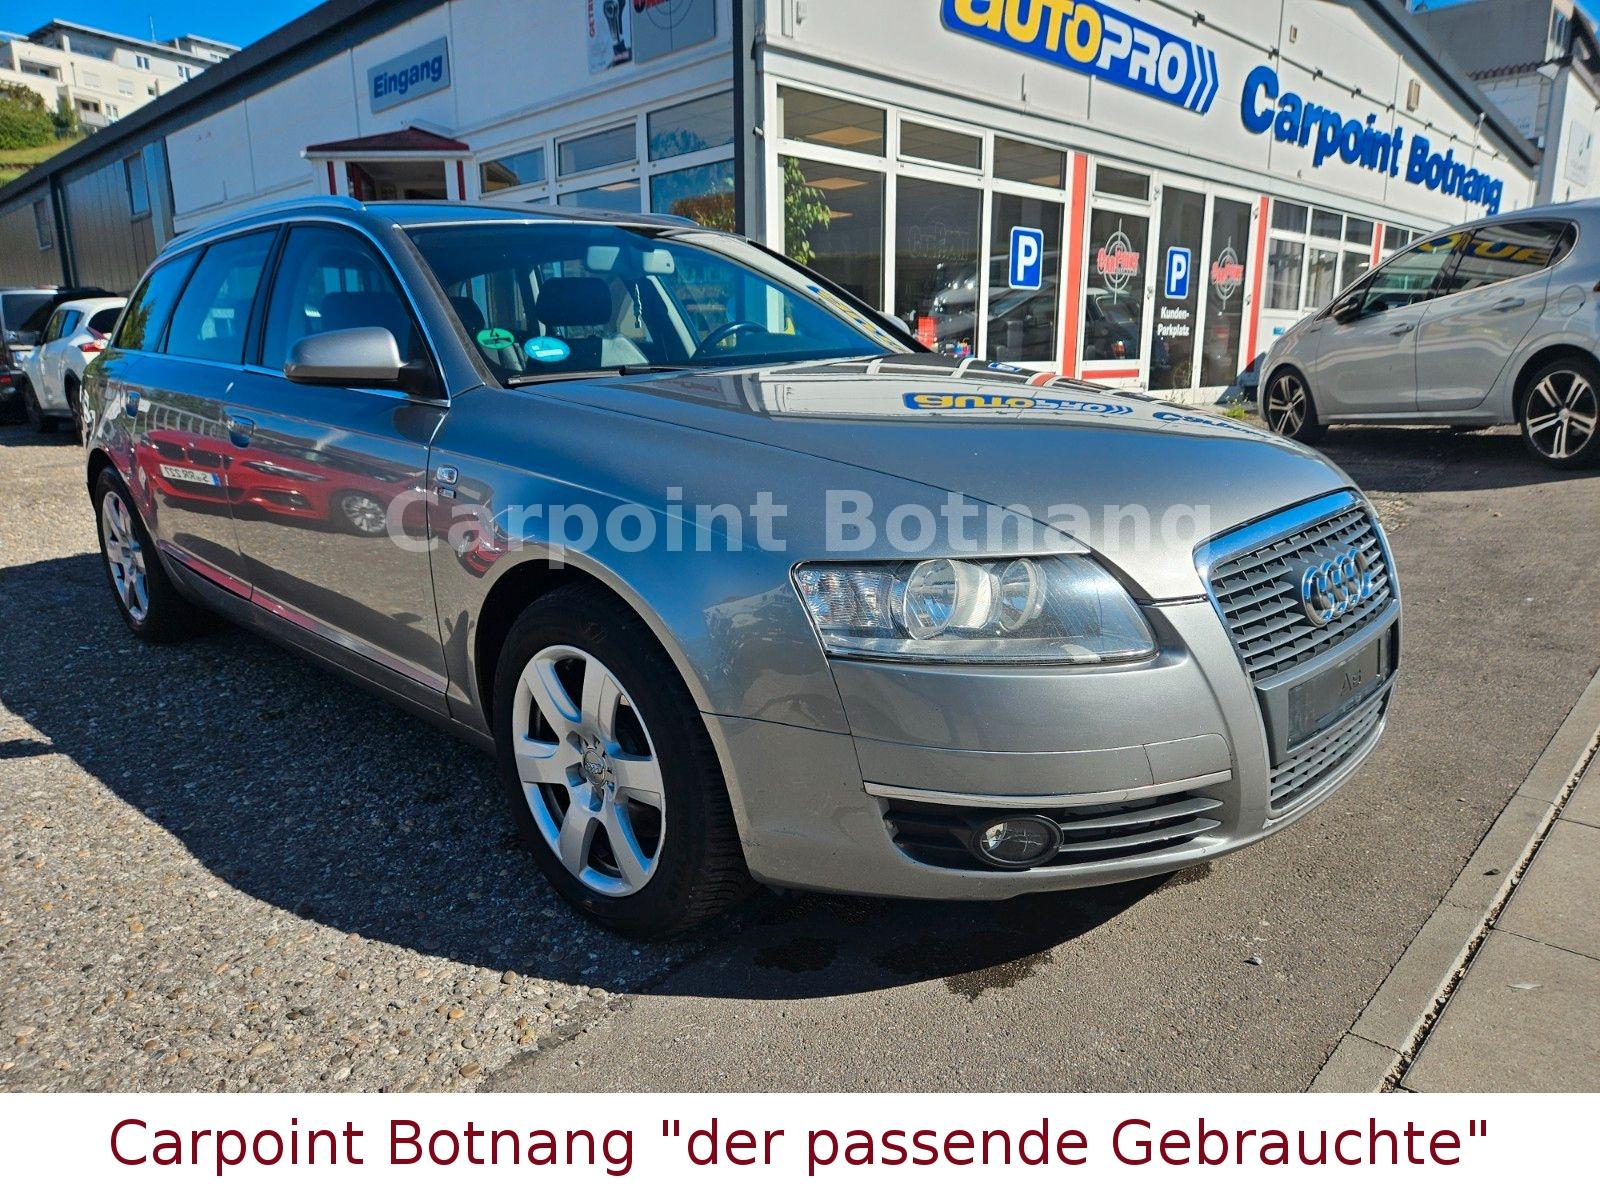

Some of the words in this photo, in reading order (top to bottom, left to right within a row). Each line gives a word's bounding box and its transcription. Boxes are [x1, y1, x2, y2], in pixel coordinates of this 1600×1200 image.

[373, 55, 443, 98] Eingang
[1241, 65, 1403, 178] Carpoint
[1406, 134, 1503, 216] Botnang
[1017, 234, 1038, 282] P
[1170, 253, 1187, 293] P
[1157, 323, 1190, 338] Parkplatz
[1160, 306, 1190, 320] Kunden-
